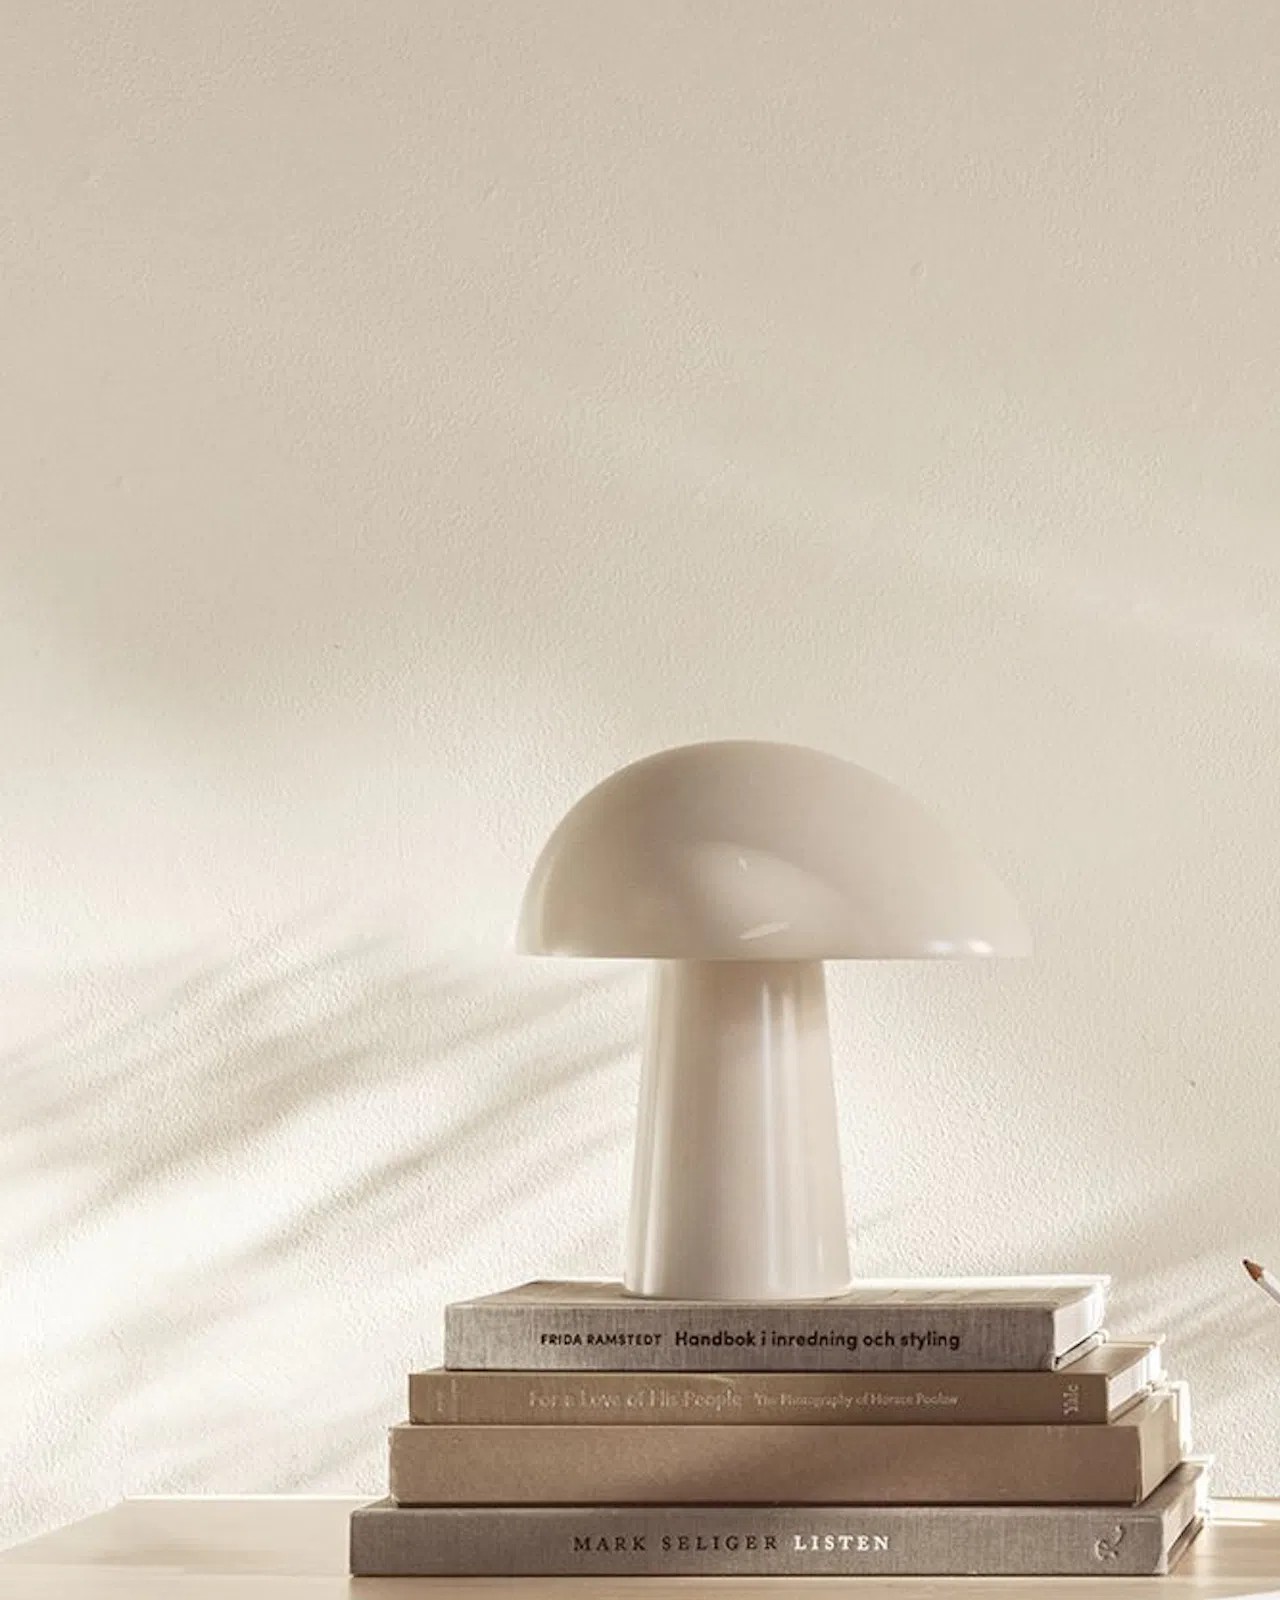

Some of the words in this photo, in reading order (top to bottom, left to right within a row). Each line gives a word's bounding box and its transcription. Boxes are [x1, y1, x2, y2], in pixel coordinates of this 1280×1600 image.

[541, 1333, 582, 1346] FRIDA
[587, 1333, 662, 1346] RAMSTEDT
[675, 1331, 756, 1347] Handbok
[760, 1330, 766, 1346] i
[772, 1330, 857, 1351] inredning
[863, 1331, 894, 1347] och
[900, 1330, 960, 1351] styling
[573, 1536, 647, 1551] MARK
[662, 1536, 778, 1551] SELIGER
[794, 1534, 890, 1551] LISTEN
